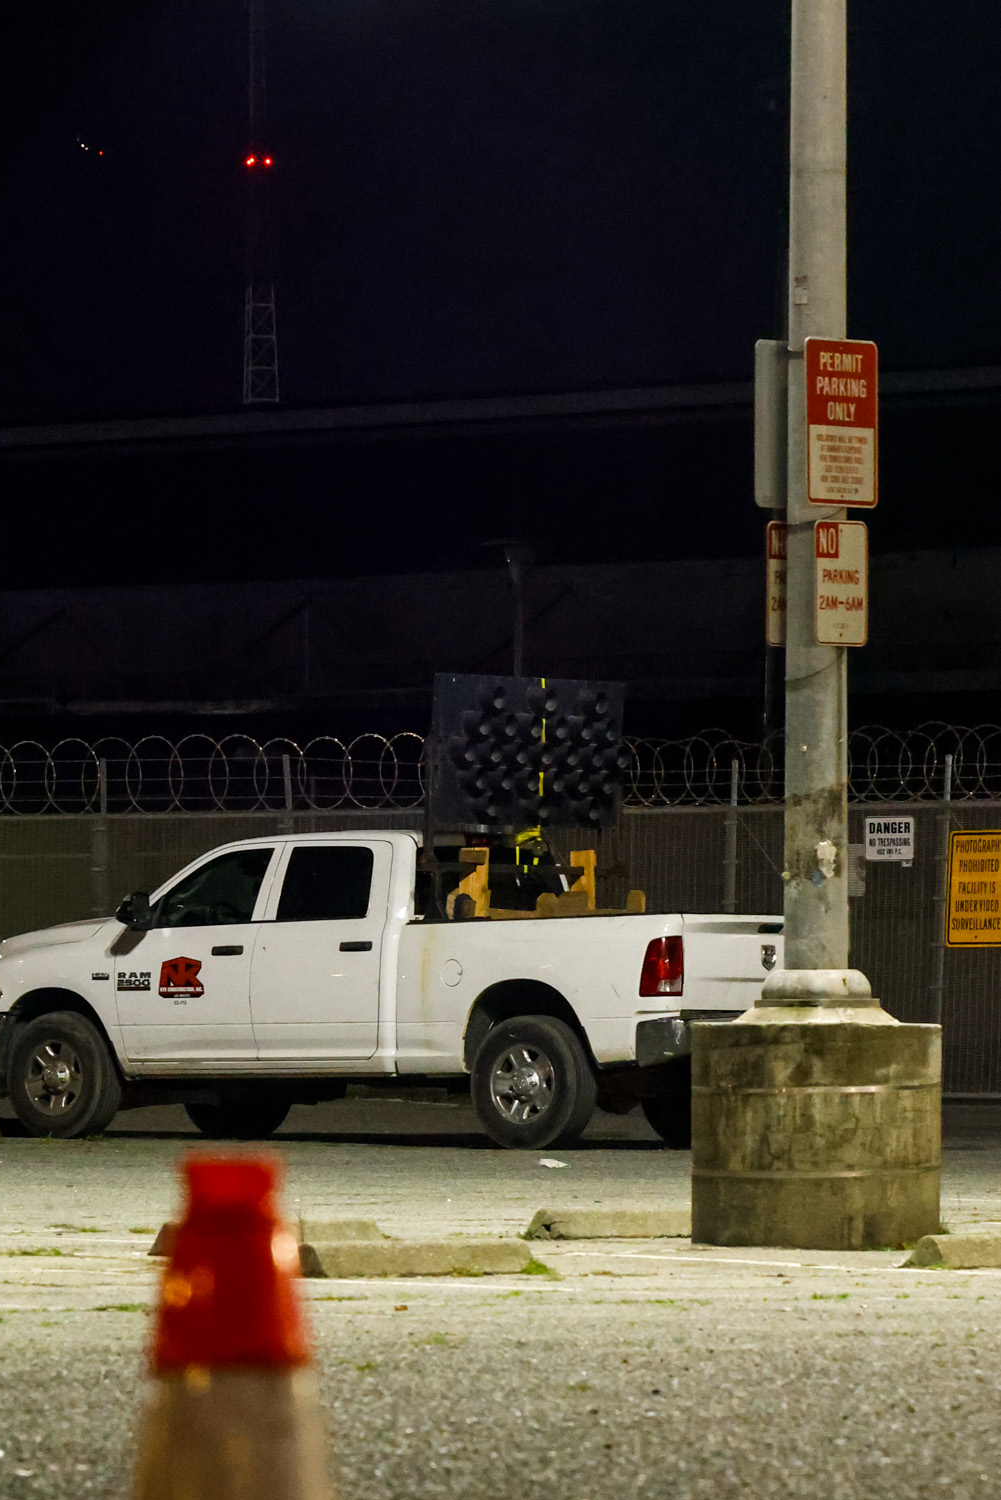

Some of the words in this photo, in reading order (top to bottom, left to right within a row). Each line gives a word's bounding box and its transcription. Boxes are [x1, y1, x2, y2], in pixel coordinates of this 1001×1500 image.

[820, 352, 863, 373] PERMIT
[816, 376, 867, 398] PARKING
[827, 401, 856, 421] ONLY
[819, 528, 836, 554] NO
[822, 569, 860, 585] PARKING
[869, 821, 910, 834] DANGER
[877, 837, 911, 847] TRESPASSING
[955, 839, 1001, 853] PHOTOGRAPH
[958, 881, 987, 894] FACILITY
[989, 881, 996, 894] IS
[955, 899, 978, 912] UNDER
[979, 899, 999, 912] VIDEO
[951, 917, 1001, 931] SURVEILLANCE
